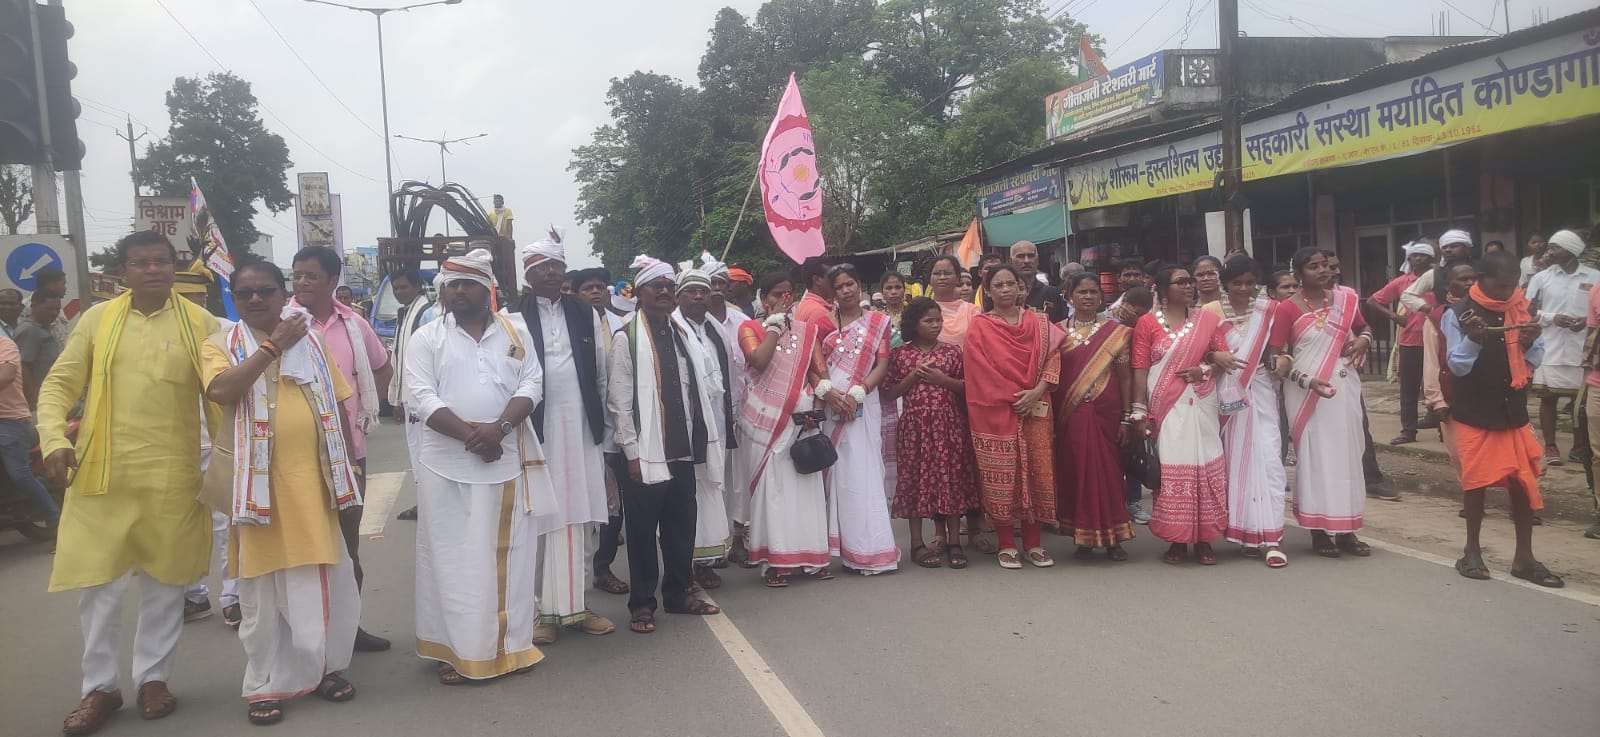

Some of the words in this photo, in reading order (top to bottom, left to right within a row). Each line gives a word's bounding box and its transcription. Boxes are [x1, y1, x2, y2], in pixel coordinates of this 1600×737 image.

[1246, 112, 1309, 165] सहकारी
[1376, 76, 1464, 132] मर्यादित
[1472, 30, 1600, 110] कोण्डागाँ
[139, 199, 186, 220] विश्राम
